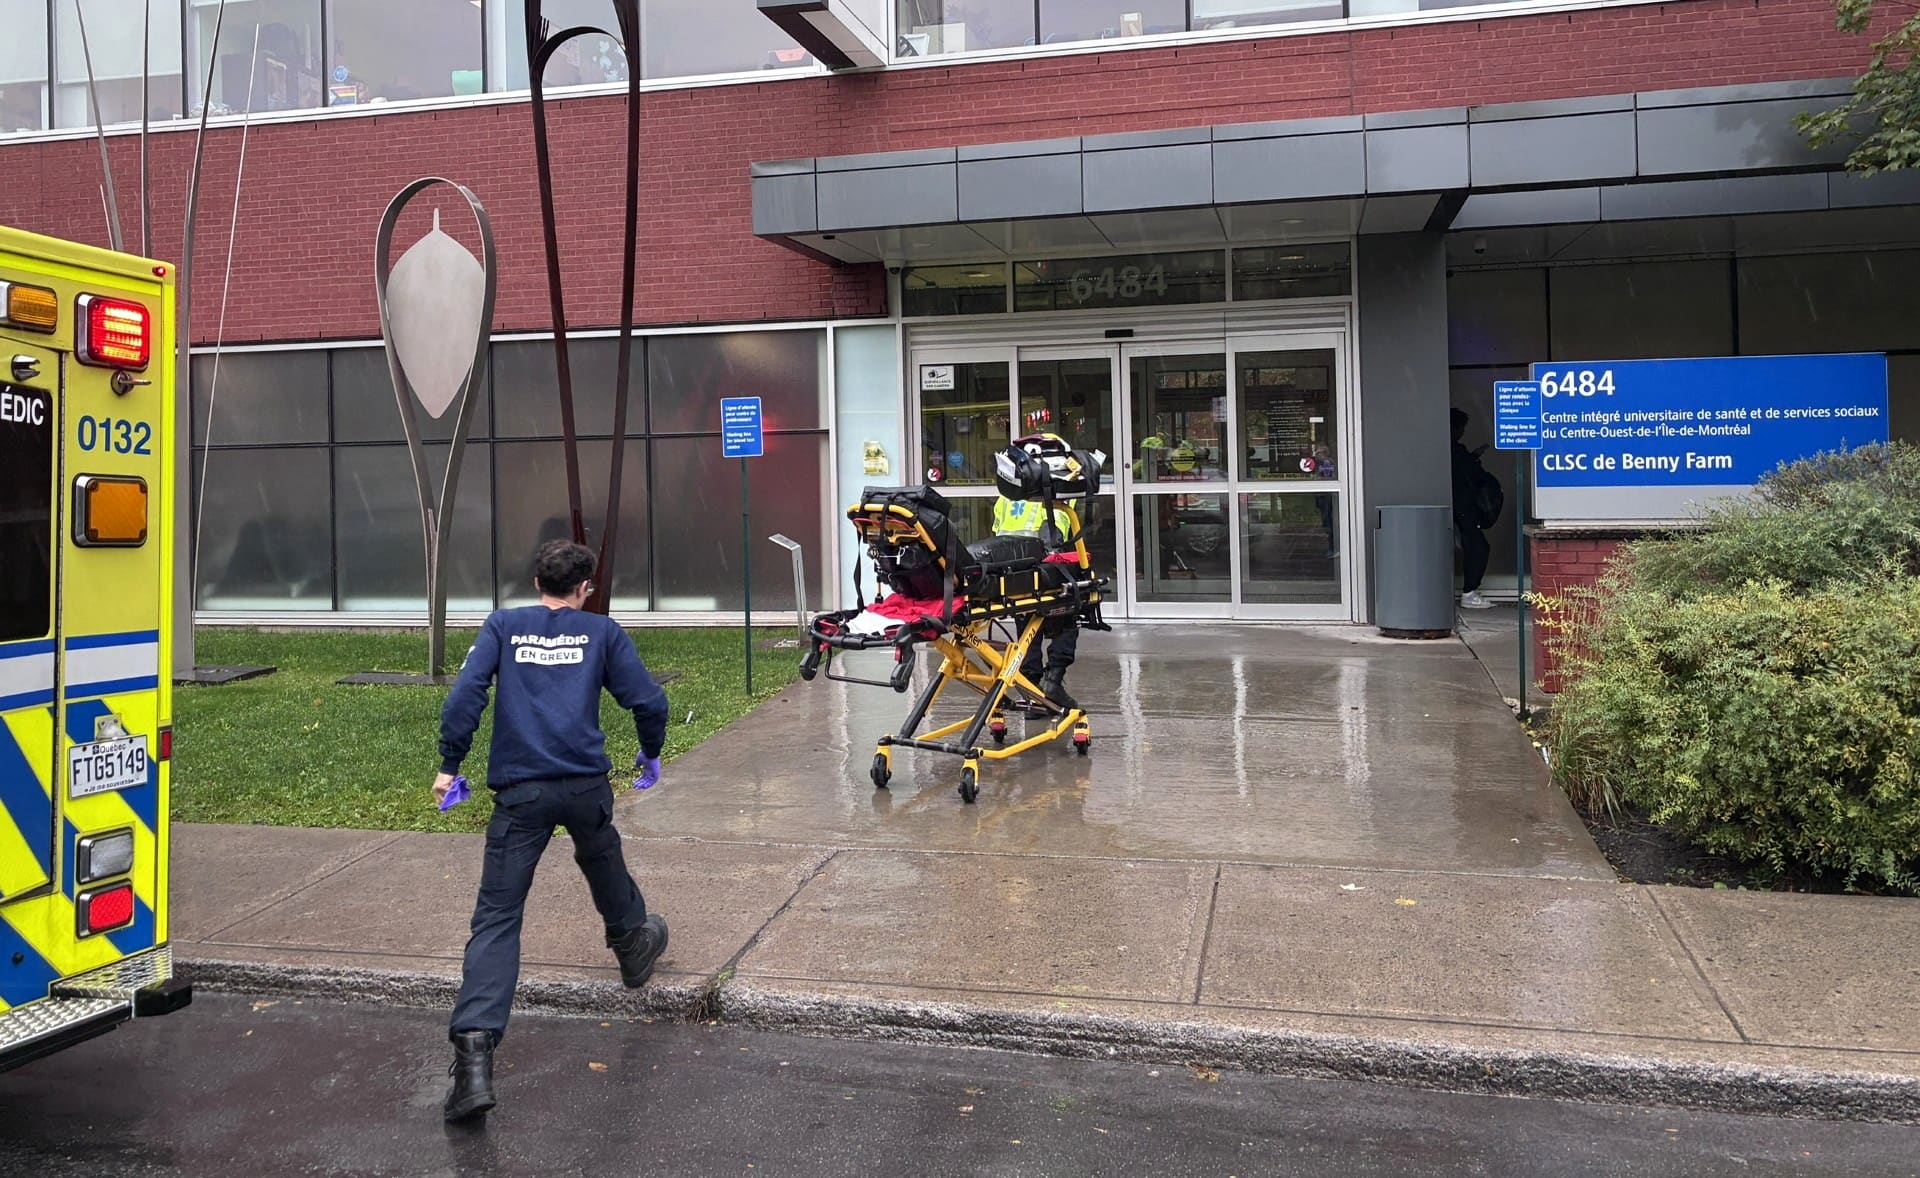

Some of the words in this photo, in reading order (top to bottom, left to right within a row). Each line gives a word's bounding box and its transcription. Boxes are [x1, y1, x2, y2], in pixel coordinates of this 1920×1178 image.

[1071, 264, 1168, 301] 6484
[1541, 370, 1616, 398] 6484
[1, 386, 44, 426] ÉDIC
[1542, 412, 1577, 423] Centre
[1581, 410, 1620, 424] intégré
[1624, 408, 1693, 422] universitaire
[1697, 408, 1712, 420] de
[1715, 407, 1747, 420] santé
[1750, 408, 1762, 419] et
[1765, 407, 1780, 419] de
[1783, 406, 1831, 418] services
[1834, 405, 1879, 417] sociaux
[77, 415, 151, 455] 0132
[1542, 427, 1557, 438] du
[1560, 423, 1751, 438] Centre-Ouest-de-l'Île-de-Montréal
[1543, 453, 1588, 470] CLSC
[1593, 453, 1616, 470] de
[1622, 452, 1680, 473] Benny
[1686, 451, 1733, 469] Farm
[511, 634, 589, 647] PARAMÉDIC
[521, 650, 536, 659] EN
[100, 743, 127, 754] Québec
[72, 747, 145, 786] FTG5149
